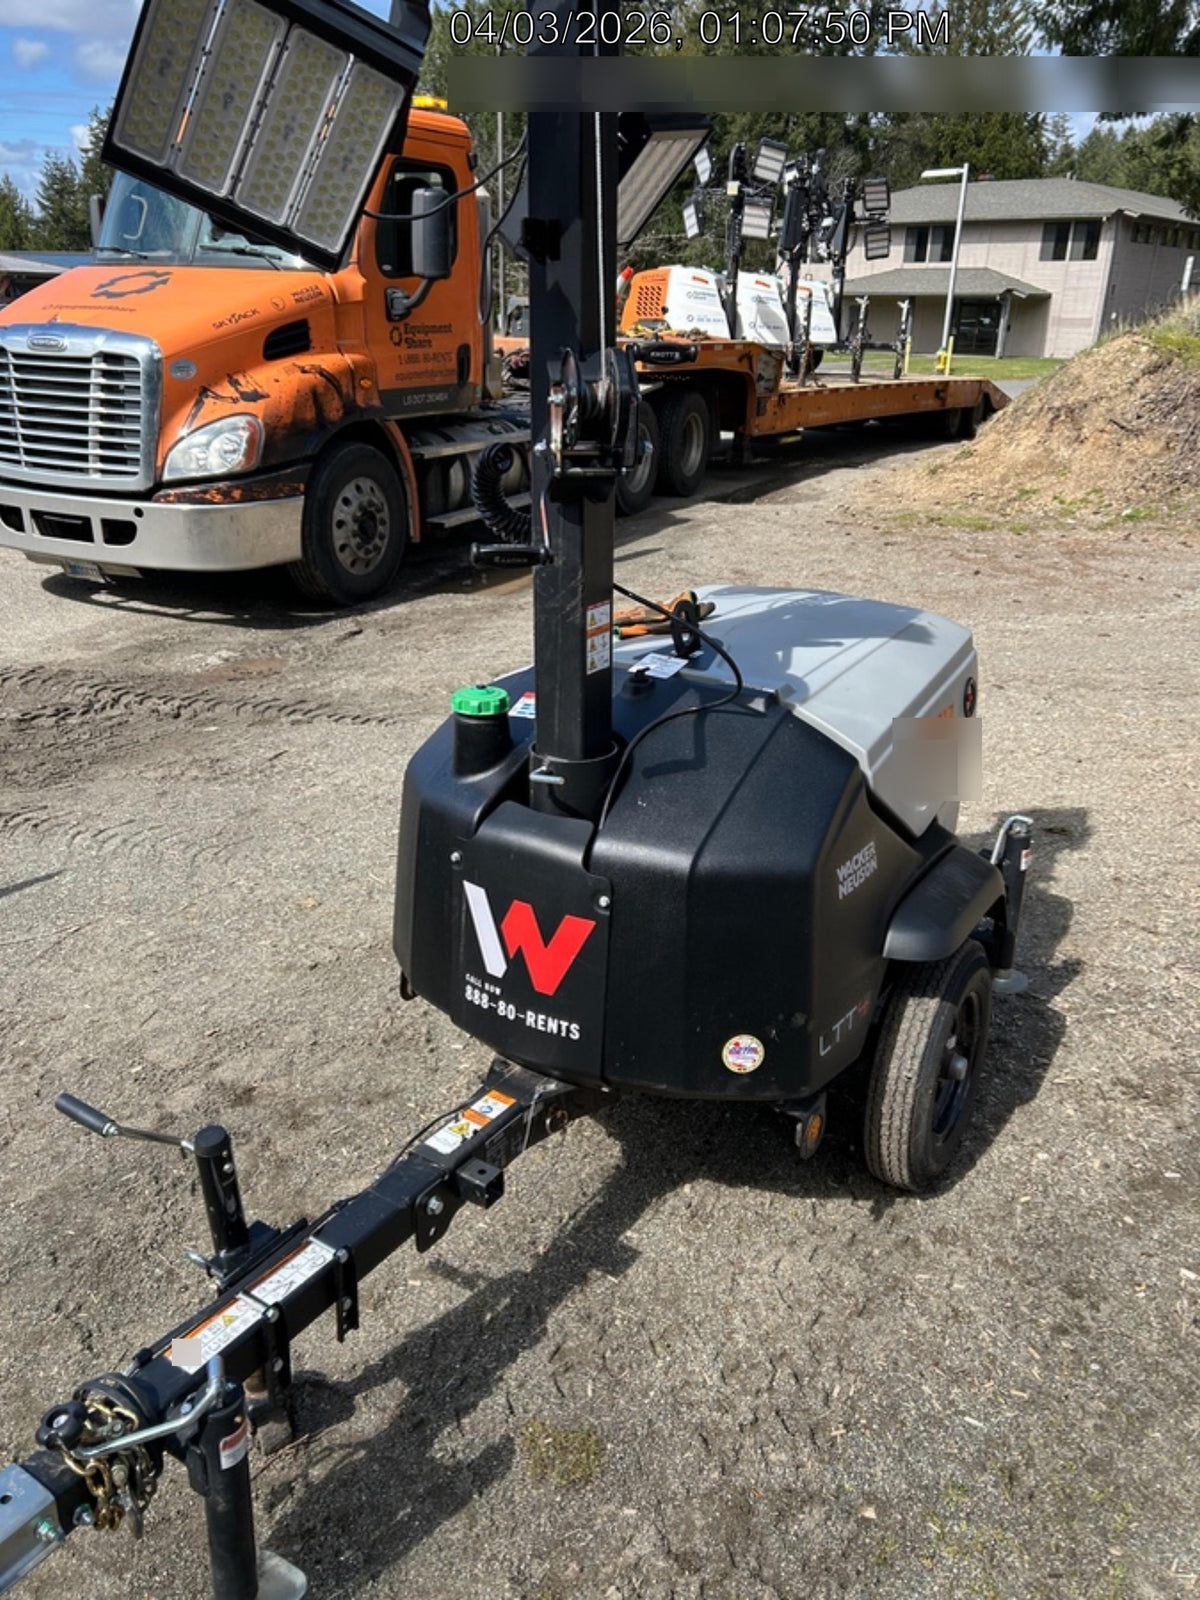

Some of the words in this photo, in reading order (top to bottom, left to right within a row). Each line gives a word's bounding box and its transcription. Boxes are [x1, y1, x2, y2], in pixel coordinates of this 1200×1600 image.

[404, 322, 453, 337] Equipment
[404, 337, 433, 350] Share
[836, 841, 877, 882] WACKER
[838, 855, 878, 900] NEUSON
[465, 973, 482, 988] CALL
[464, 984, 581, 1040] 888-80-RENTS
